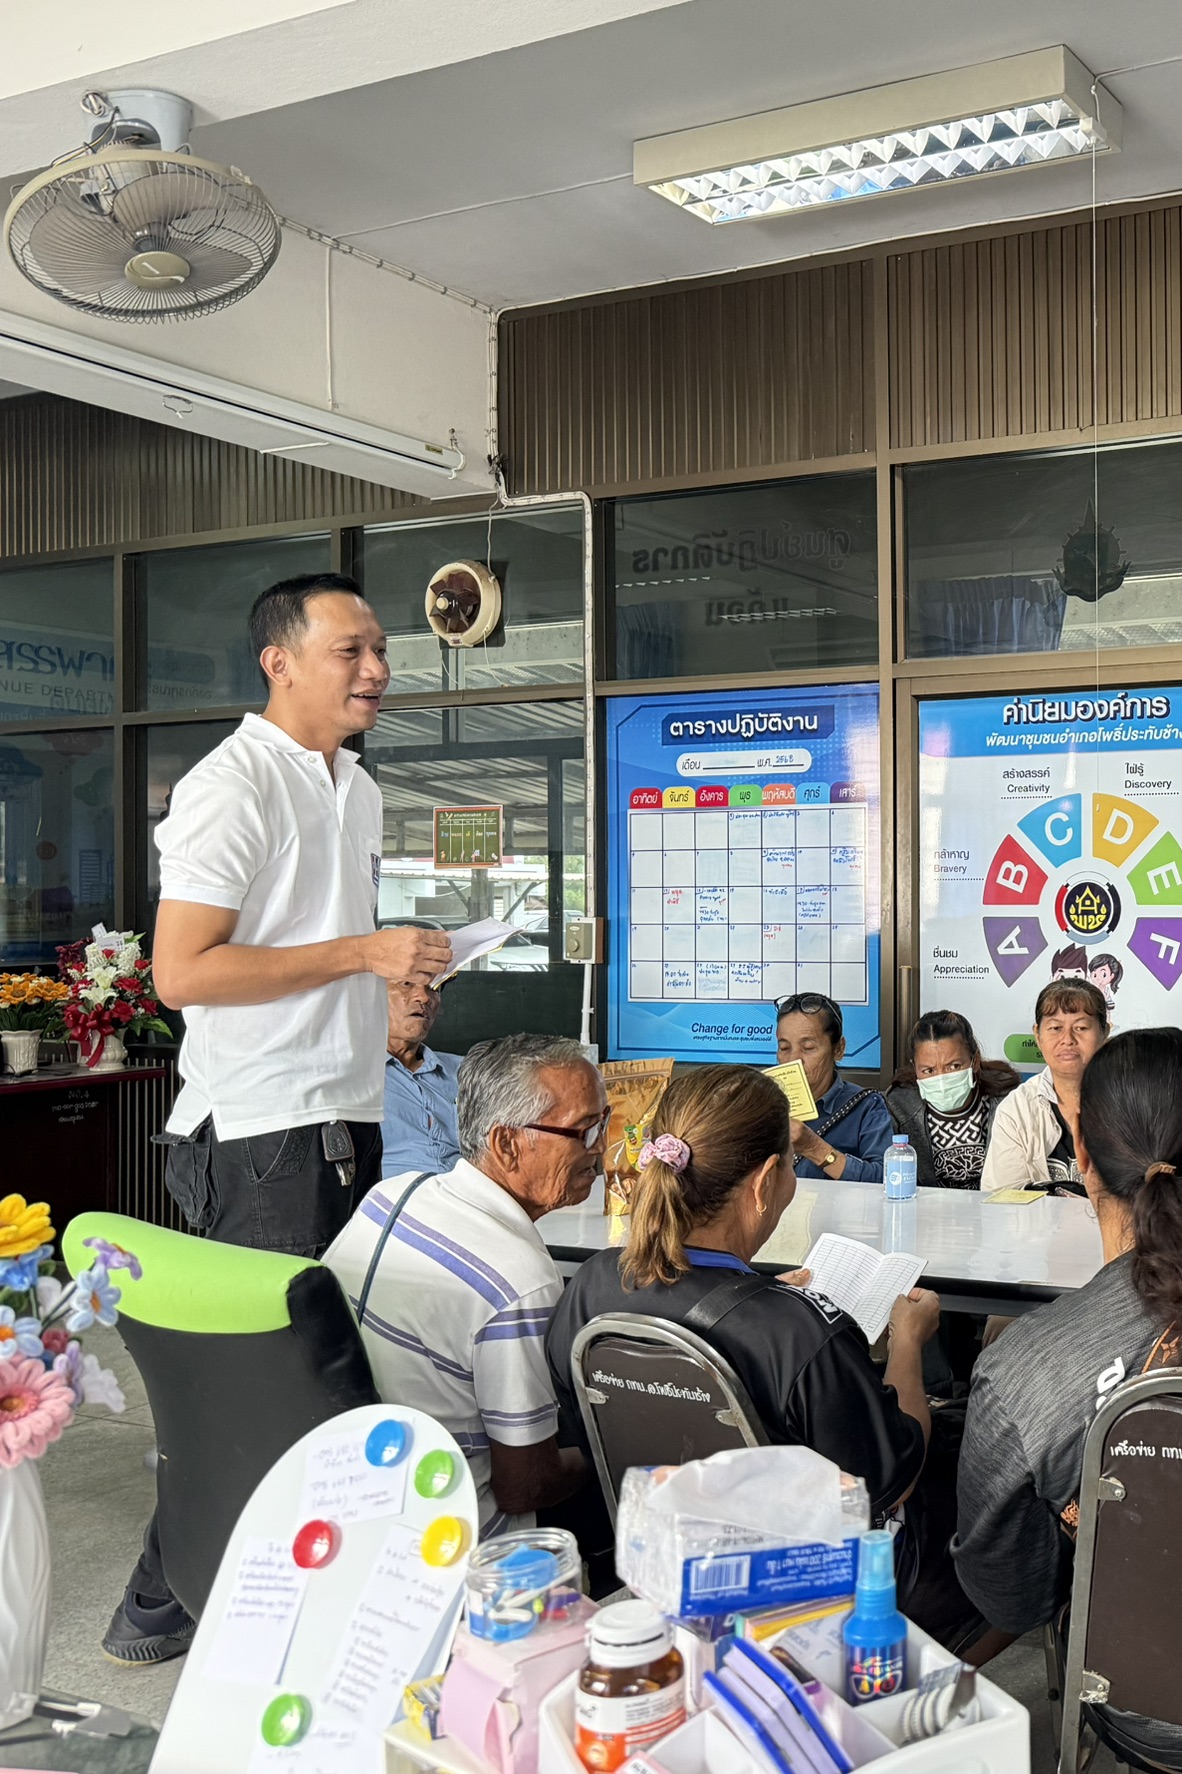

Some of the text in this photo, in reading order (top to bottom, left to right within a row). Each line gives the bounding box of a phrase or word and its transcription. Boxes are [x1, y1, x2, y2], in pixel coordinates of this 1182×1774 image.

[1003, 693, 1170, 726] ค่านิยมองค์การ
[669, 713, 818, 739] ตารางปฏิบัติงาน
[682, 758, 700, 770] เดือน
[1124, 763, 1145, 777] ใฝ่รู้
[1002, 767, 1050, 780] สร้างสรรค์
[1007, 783, 1050, 794] Creativity
[1125, 779, 1172, 791] Discovery
[632, 784, 857, 805] อาทิตย์ จันทร์ อังคาร พุธ พฤหัสบดี ศุกร์ เสาร์
[1044, 812, 1073, 846] C
[1102, 808, 1134, 845] D
[934, 864, 967, 876] Bravery
[996, 860, 1029, 894] B
[997, 925, 1030, 956] A
[933, 947, 958, 959] ชื่นชม
[1150, 932, 1181, 965] F
[934, 964, 990, 975] Appreciation
[691, 1022, 773, 1036] Change for good
[1110, 1440, 1156, 1457] เครือข่าย
